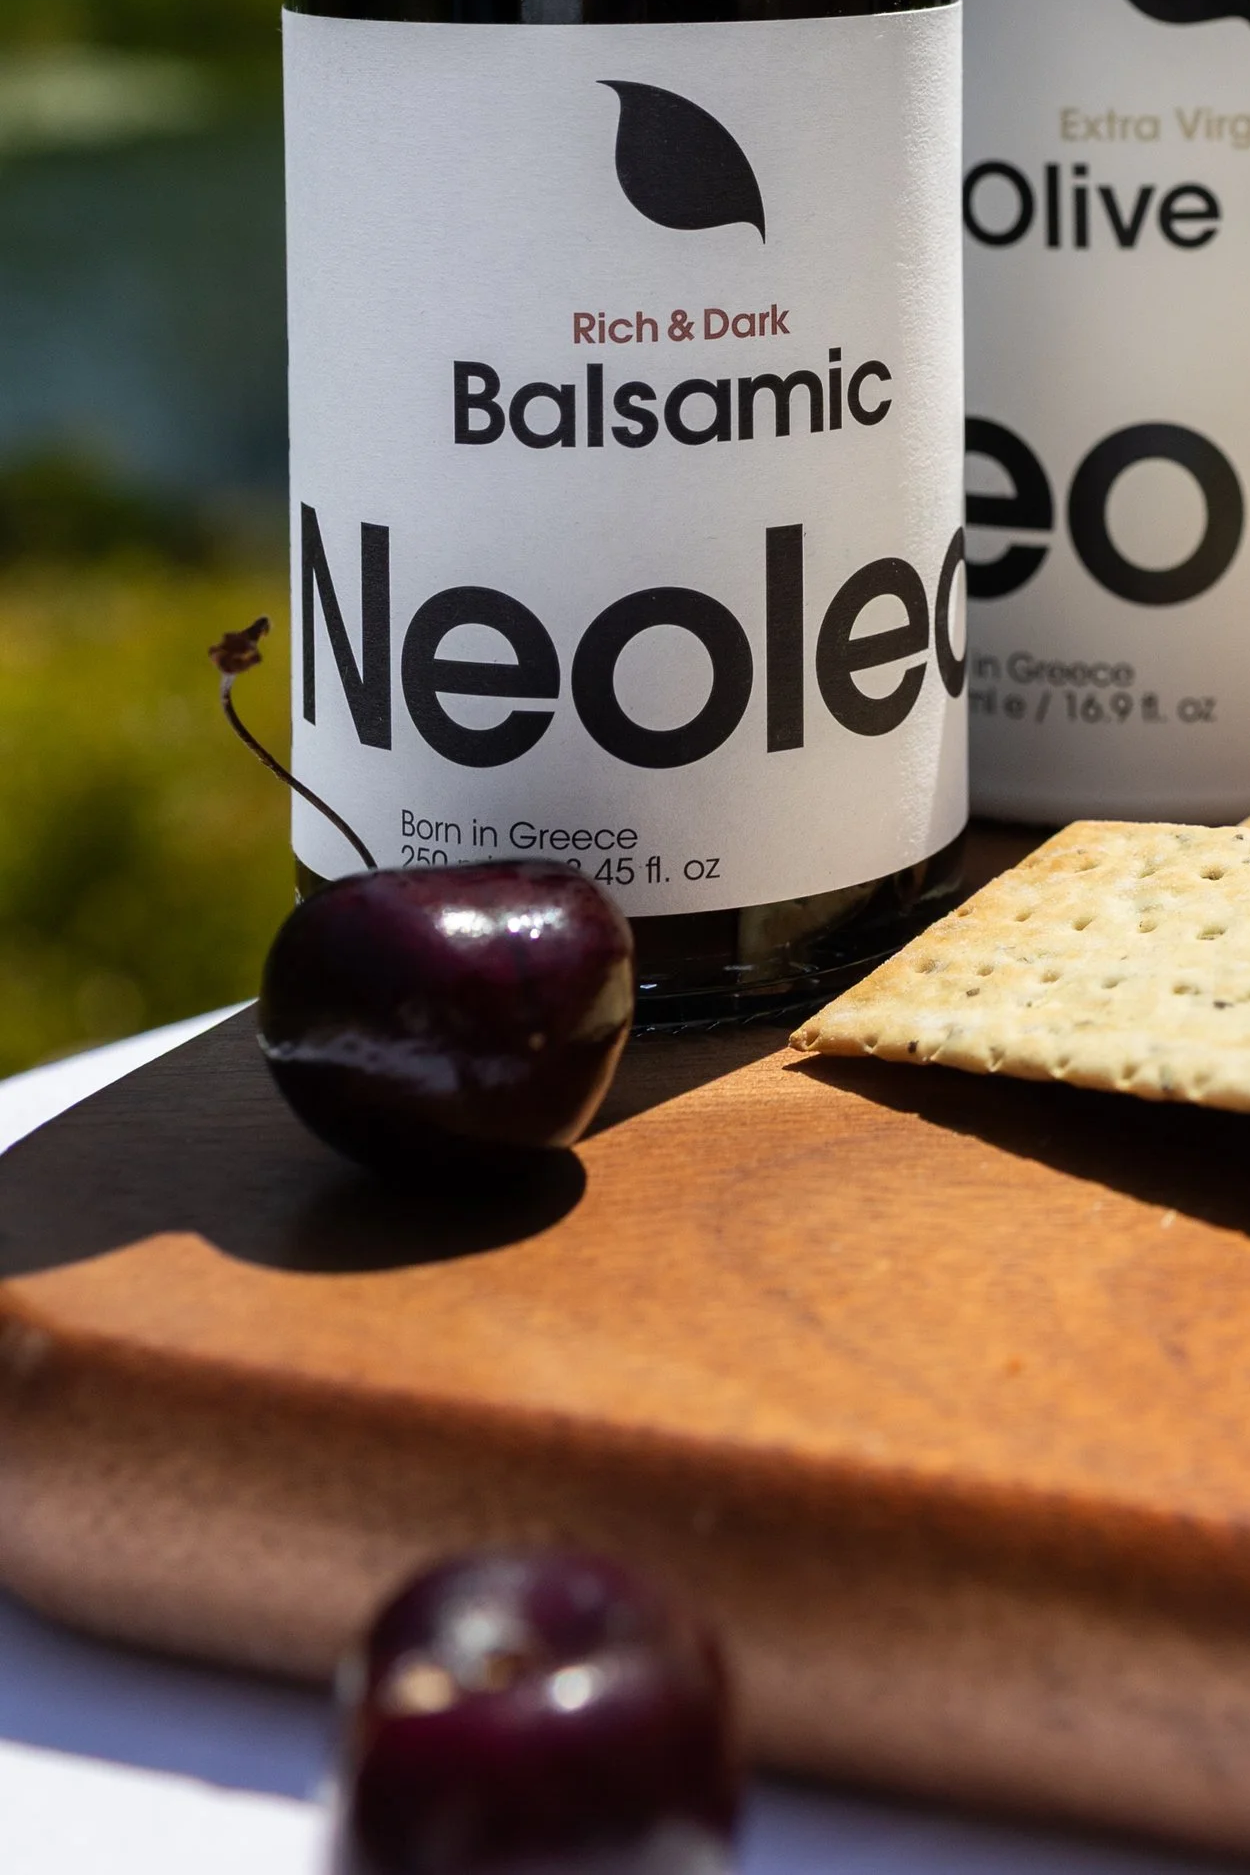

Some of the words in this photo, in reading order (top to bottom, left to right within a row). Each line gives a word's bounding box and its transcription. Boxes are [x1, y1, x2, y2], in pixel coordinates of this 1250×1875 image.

[1059, 106, 1160, 143] Extra
[962, 159, 1221, 251] Olive
[573, 311, 659, 344] Rich
[667, 309, 695, 341] &
[703, 304, 790, 340] Dark
[453, 347, 893, 449] Balsamic
[1006, 650, 1136, 689] Greece
[1063, 689, 1135, 725] 16.9
[1175, 695, 1217, 725] oz
[402, 808, 461, 845] Born
[472, 818, 498, 848] in
[509, 821, 638, 850] Greece
[645, 855, 670, 884] fl.
[683, 858, 721, 881] oz
